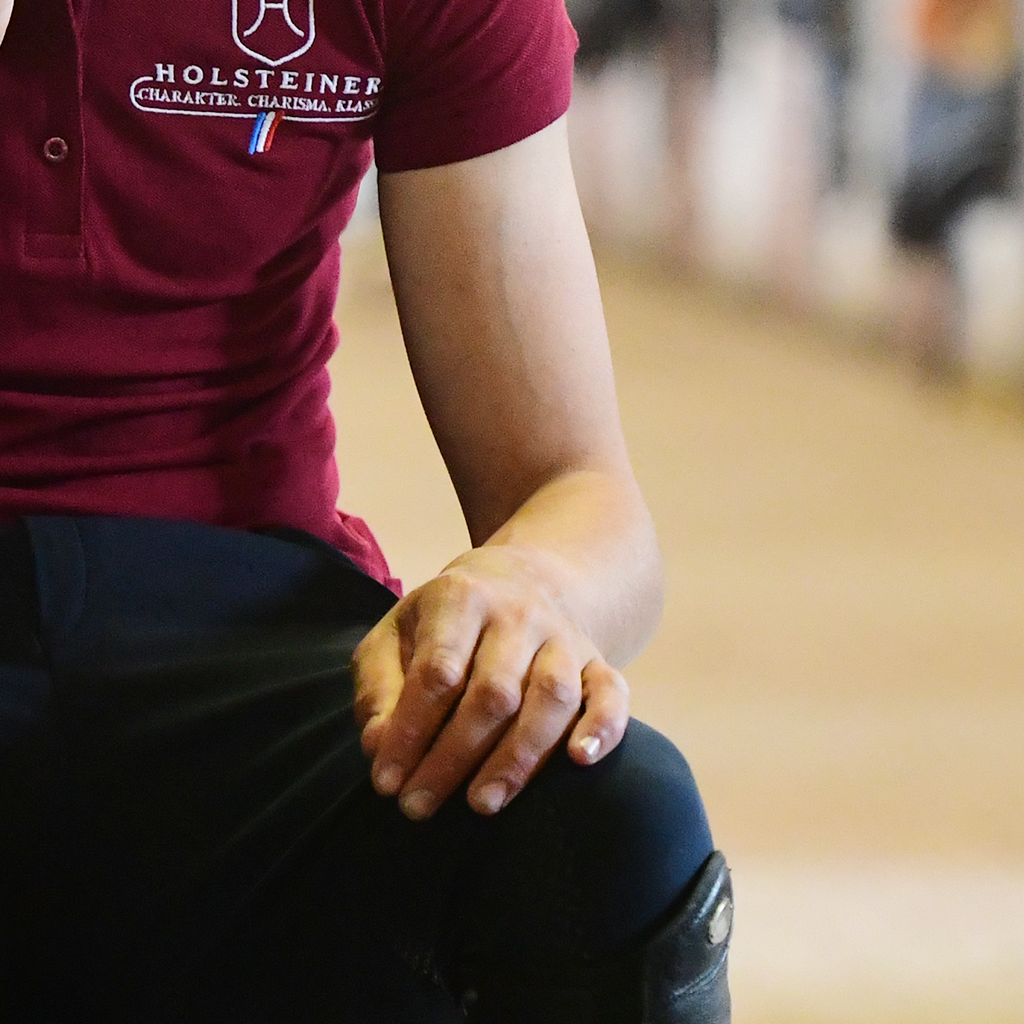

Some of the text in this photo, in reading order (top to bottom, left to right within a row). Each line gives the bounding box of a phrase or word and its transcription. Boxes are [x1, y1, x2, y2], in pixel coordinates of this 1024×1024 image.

[155, 63, 382, 96] HOLSTEINER
[137, 86, 242, 107] CHARAKTER.
[248, 94, 331, 113] CHARISMA.
